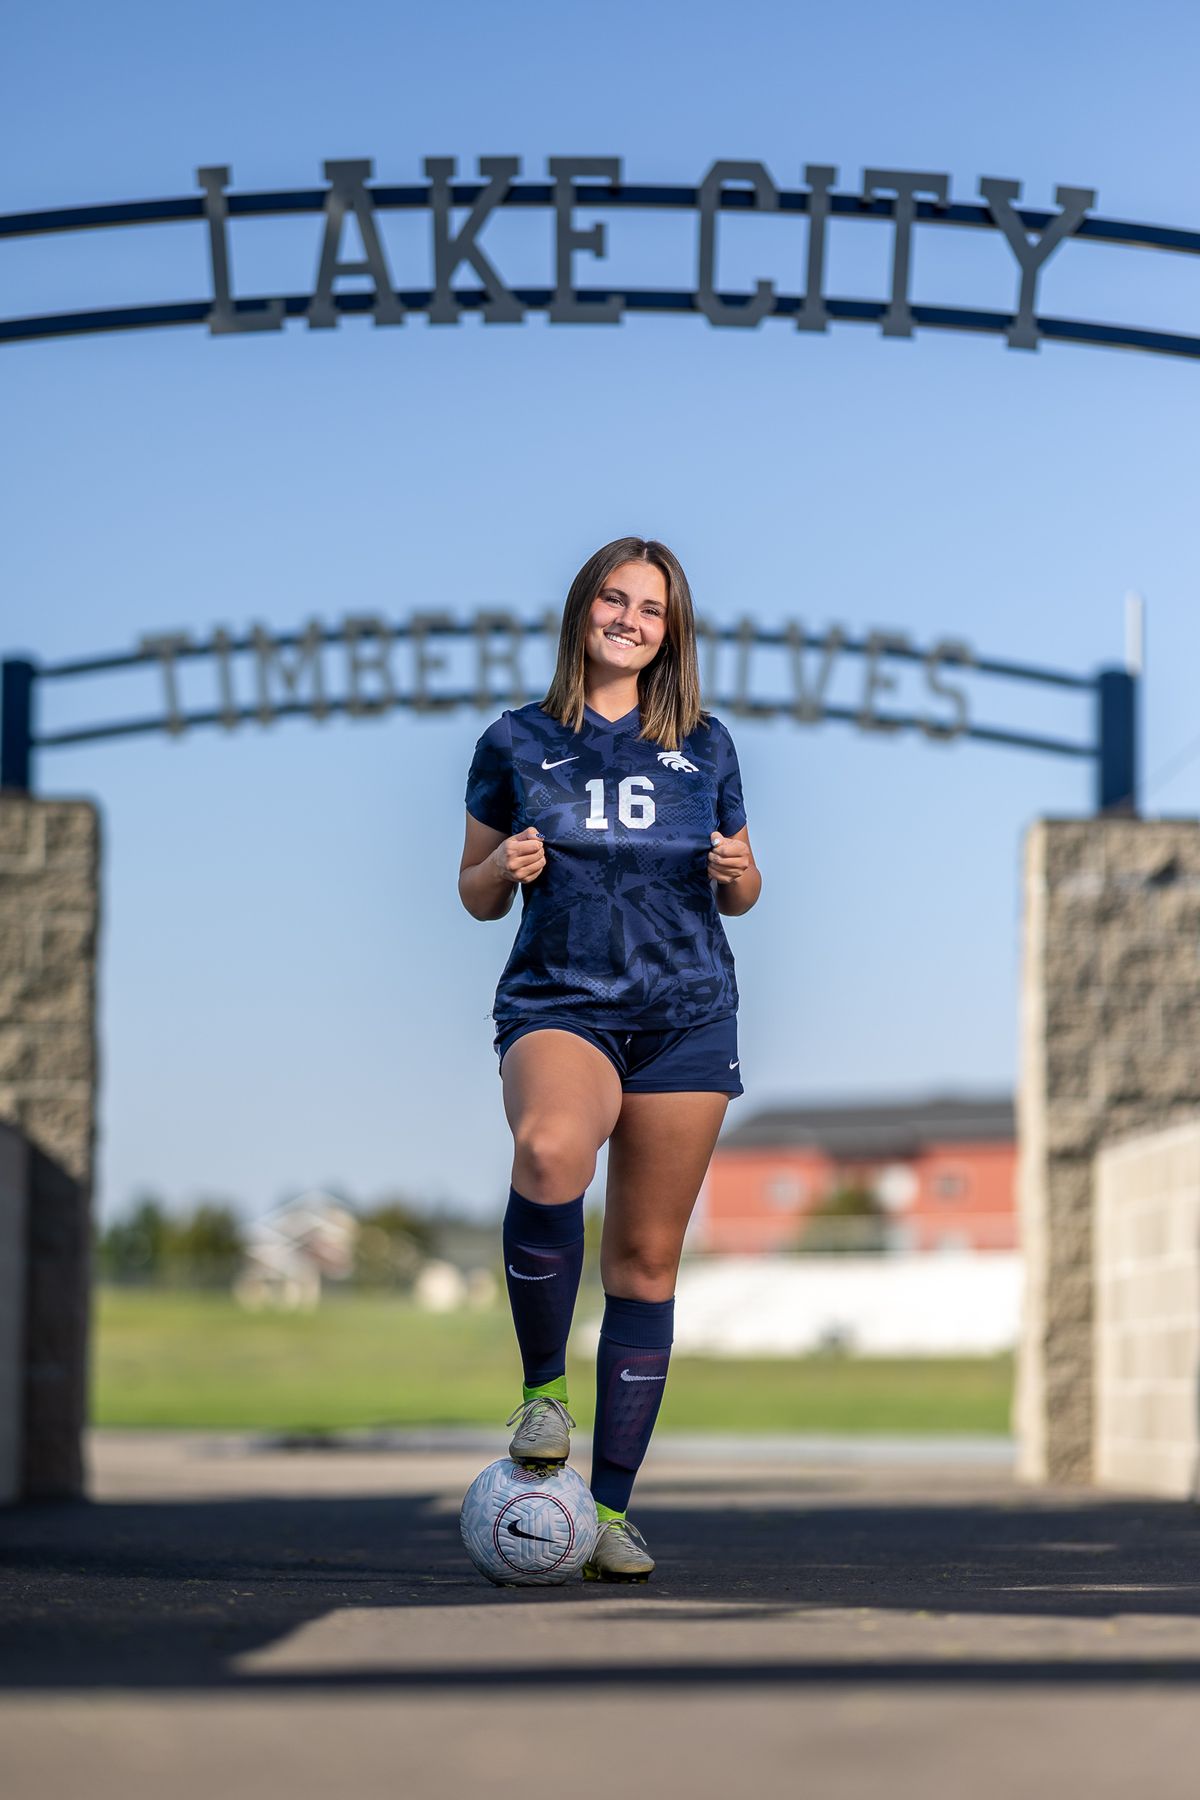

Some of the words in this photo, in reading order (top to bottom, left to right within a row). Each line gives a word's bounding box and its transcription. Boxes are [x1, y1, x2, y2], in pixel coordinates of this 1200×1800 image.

[196, 156, 626, 335] LAKE
[695, 159, 1096, 350] CITY
[138, 607, 975, 739] TIMBERLVES
[585, 775, 656, 829] 16
